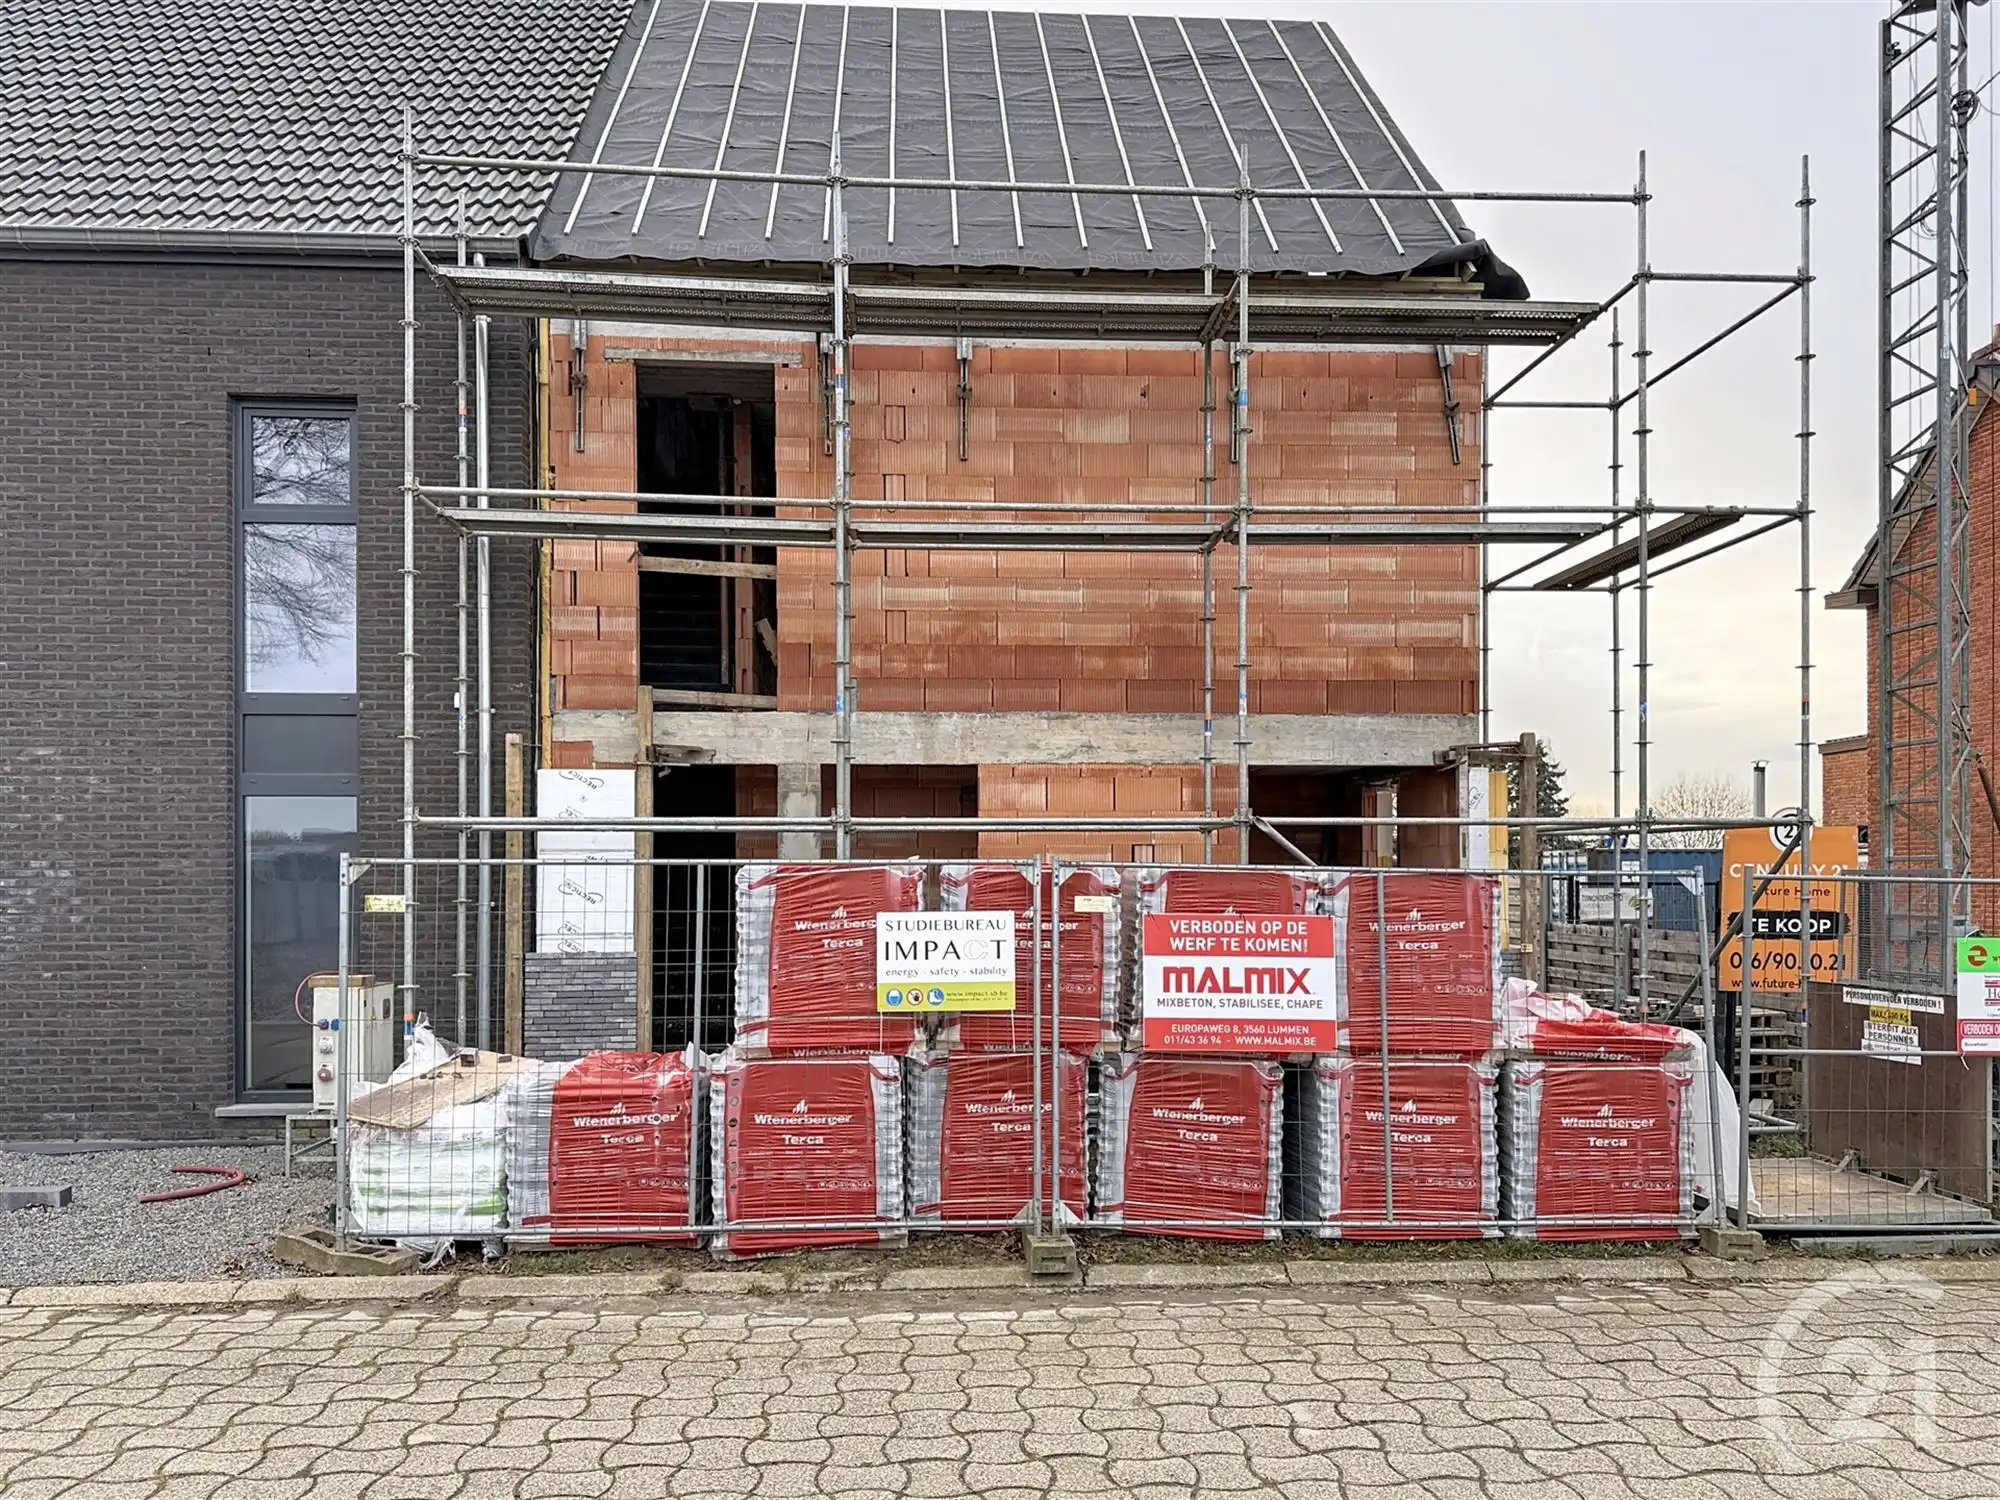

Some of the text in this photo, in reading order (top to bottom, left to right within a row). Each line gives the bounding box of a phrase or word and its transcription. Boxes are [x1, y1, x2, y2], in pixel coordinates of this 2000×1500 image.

[1729, 863, 1827, 878] CNUY
[1795, 887, 1831, 897] Hme
[885, 919, 1006, 932] STUDIEBUREAU
[1170, 920, 1307, 935] VERBODEN OP DE
[1369, 920, 1466, 932] Wenerberger
[1776, 918, 1832, 933] KOOP
[822, 938, 864, 950] Terca
[885, 939, 1007, 960] IMPACT
[1170, 937, 1308, 953] WERF TE KOMEN!
[1730, 951, 1846, 970] 06/90.0.21
[885, 969, 919, 978] energy
[929, 967, 960, 977] safety
[969, 966, 1008, 977] stability
[1163, 966, 1311, 994] MALMIX
[1157, 999, 1323, 1010] MIXBETON, STABILISEE, CHAPE
[1902, 997, 1937, 1008] VERBODEN
[1171, 1024, 1309, 1035] EUROPAWEG 8, 3560 LUMMEN
[1901, 1026, 1918, 1036] AUX
[1964, 1024, 1994, 1035] VERBODEN
[1164, 1036, 1198, 1045] 011/43
[1200, 1037, 1210, 1045] 36
[1211, 1037, 1221, 1045] 94
[1235, 1037, 1317, 1046] WWW.MALMIX.BE
[1868, 1032, 1915, 1045] PERSONNES
[966, 1103, 1053, 1113] Wienerbere
[573, 1113, 679, 1128] Wienerberger
[754, 1114, 853, 1125] Wienerberger
[1152, 1108, 1247, 1125] Wienerberger
[1365, 1111, 1459, 1125] Winerberger
[1561, 1116, 1656, 1129] Wienerberger
[991, 1122, 1032, 1132] Terca
[782, 1134, 825, 1145] Terca
[1177, 1129, 1219, 1141] Terca
[1391, 1132, 1433, 1143] Terca
[1586, 1137, 1629, 1147] Terca
